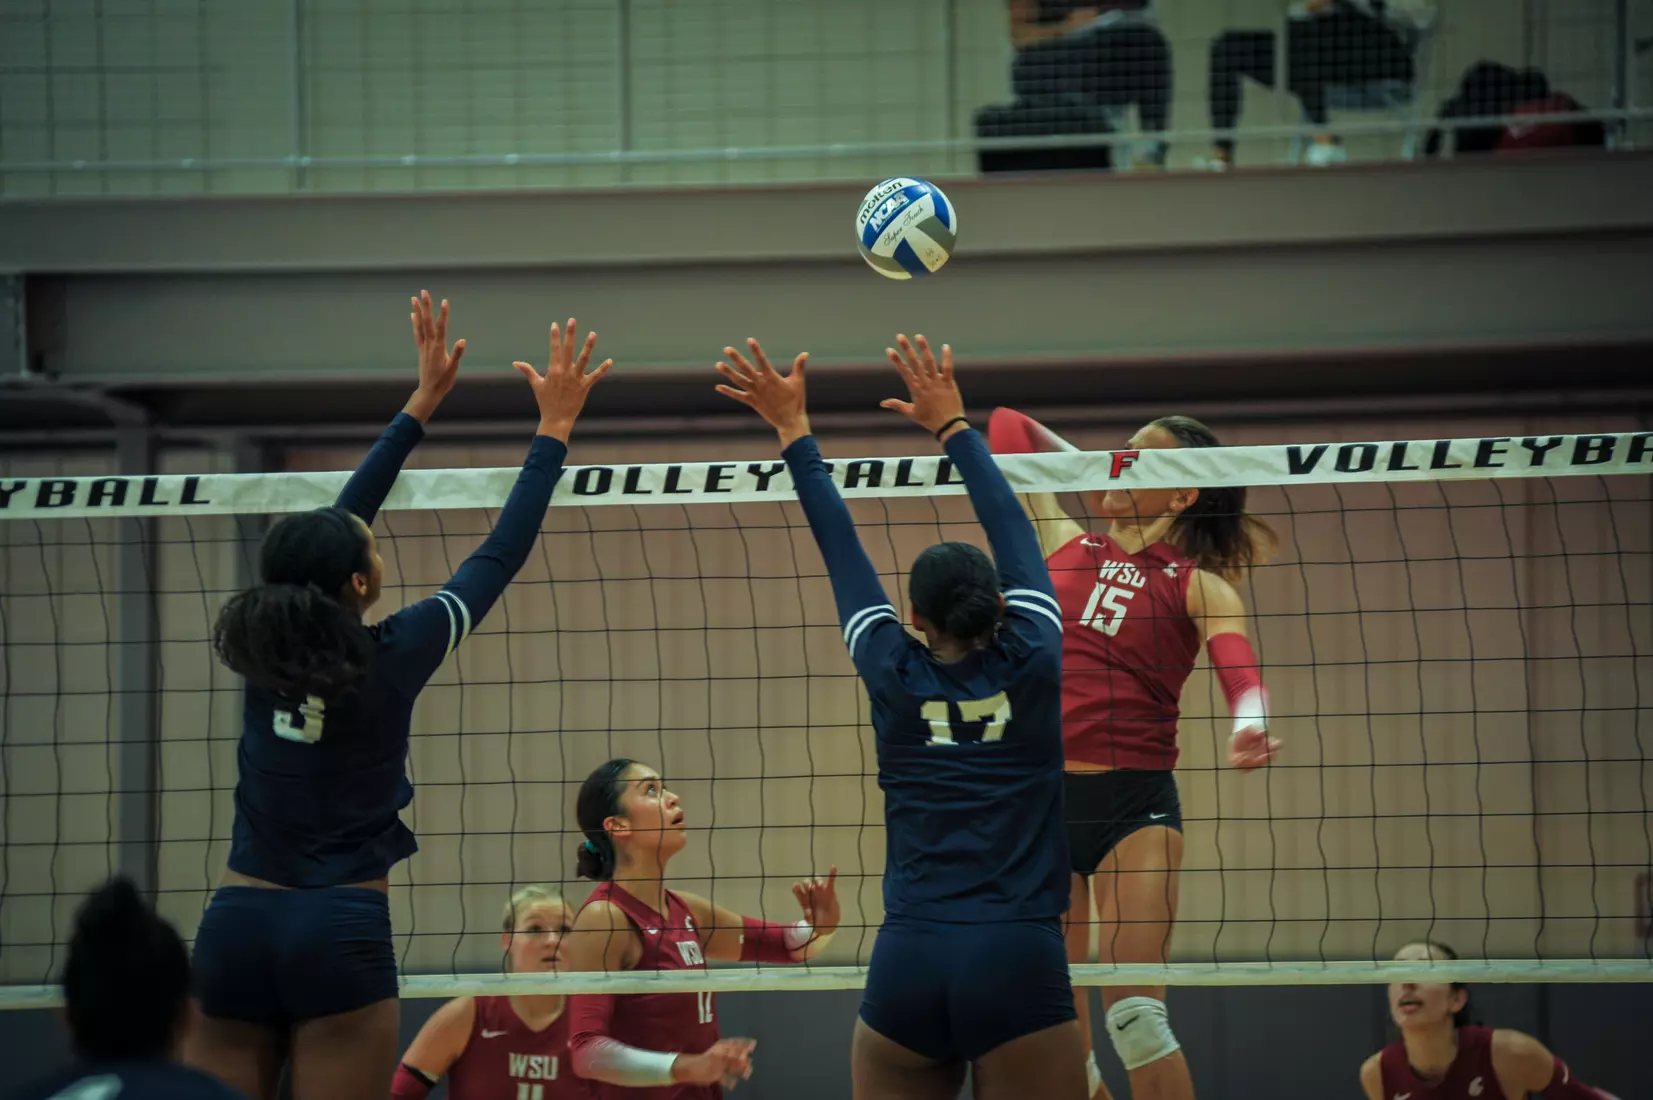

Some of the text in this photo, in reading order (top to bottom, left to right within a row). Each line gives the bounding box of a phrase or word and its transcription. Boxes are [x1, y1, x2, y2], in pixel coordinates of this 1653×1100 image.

[860, 182, 902, 225] molten
[869, 190, 909, 233] NCAA
[560, 457, 967, 496] OLLEYALL
[1108, 450, 1139, 479] F
[1099, 559, 1146, 588] WSU
[1079, 581, 1135, 637] 15
[920, 690, 1012, 746] 17
[508, 1052, 559, 1080] WSU
